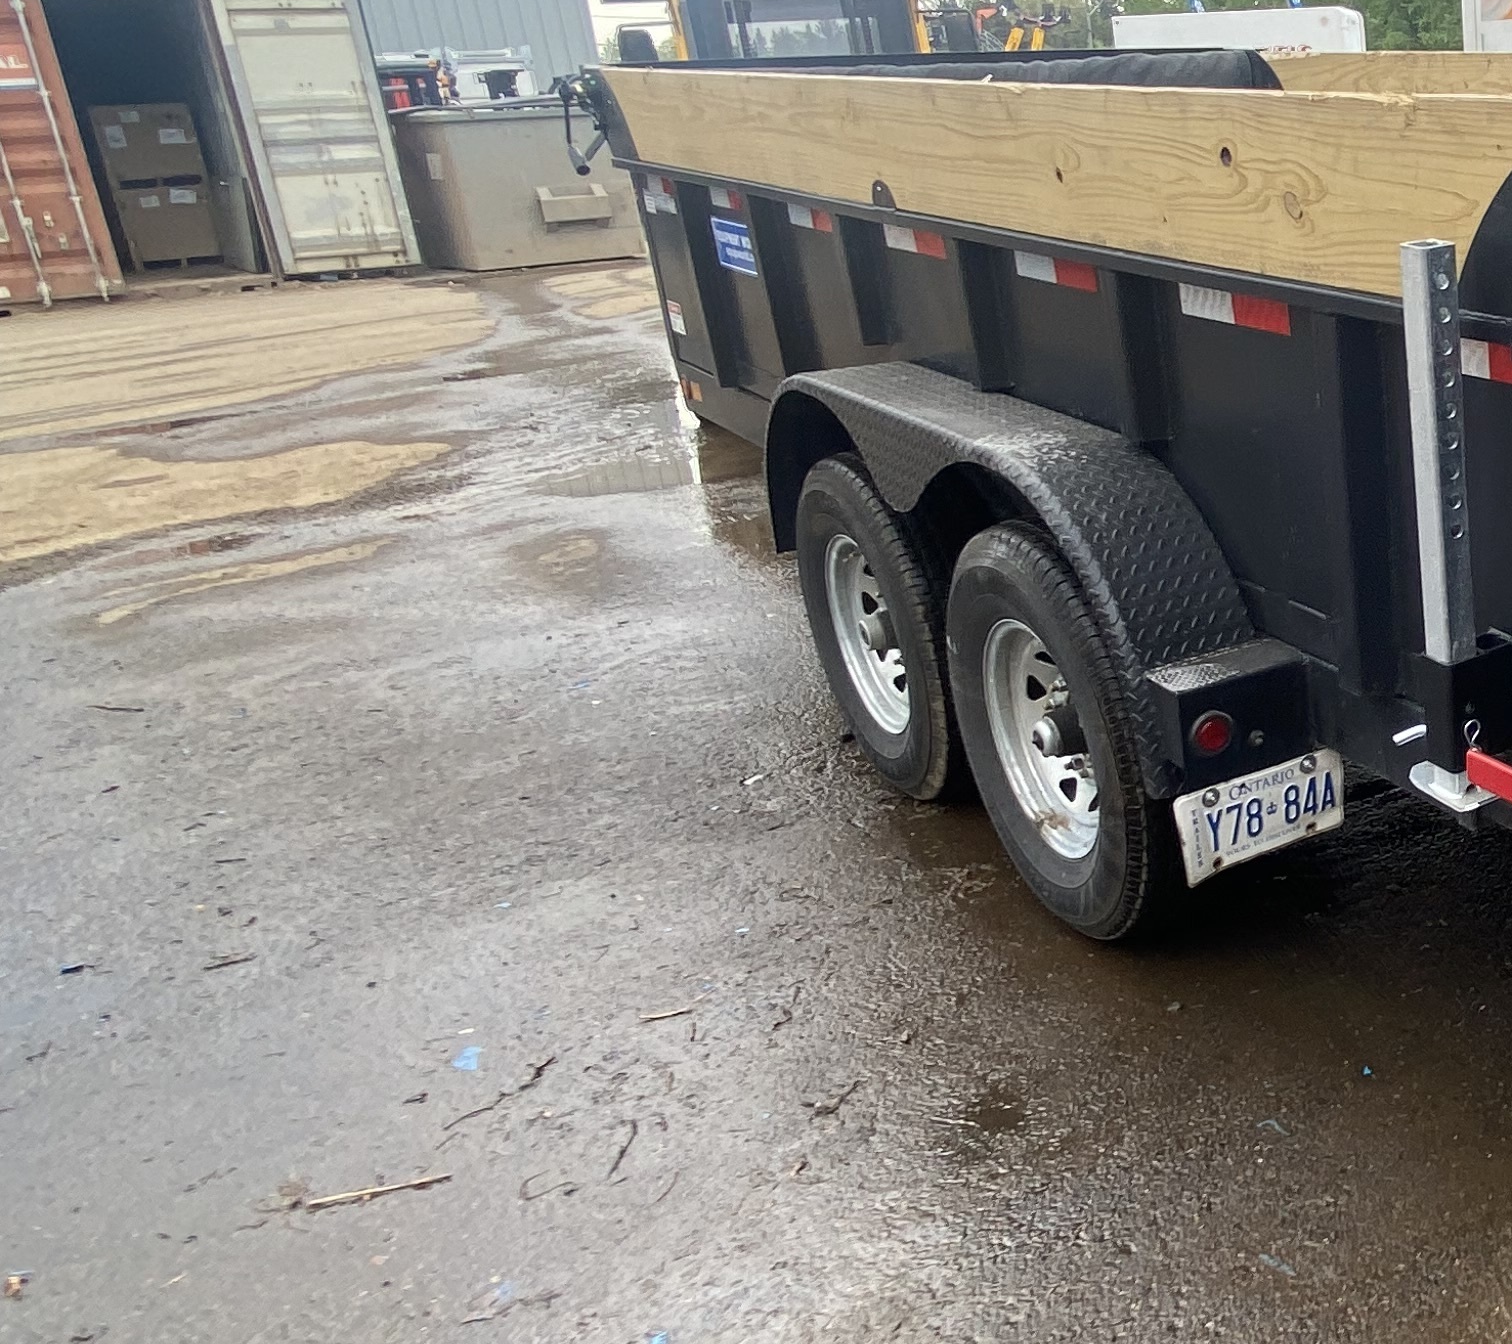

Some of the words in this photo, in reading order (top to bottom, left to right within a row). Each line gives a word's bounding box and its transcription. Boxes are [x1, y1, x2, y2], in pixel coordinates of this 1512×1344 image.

[1206, 797, 1264, 853] Y78
[1284, 771, 1336, 825] 84A
[1229, 768, 1295, 801] ONTARIO
